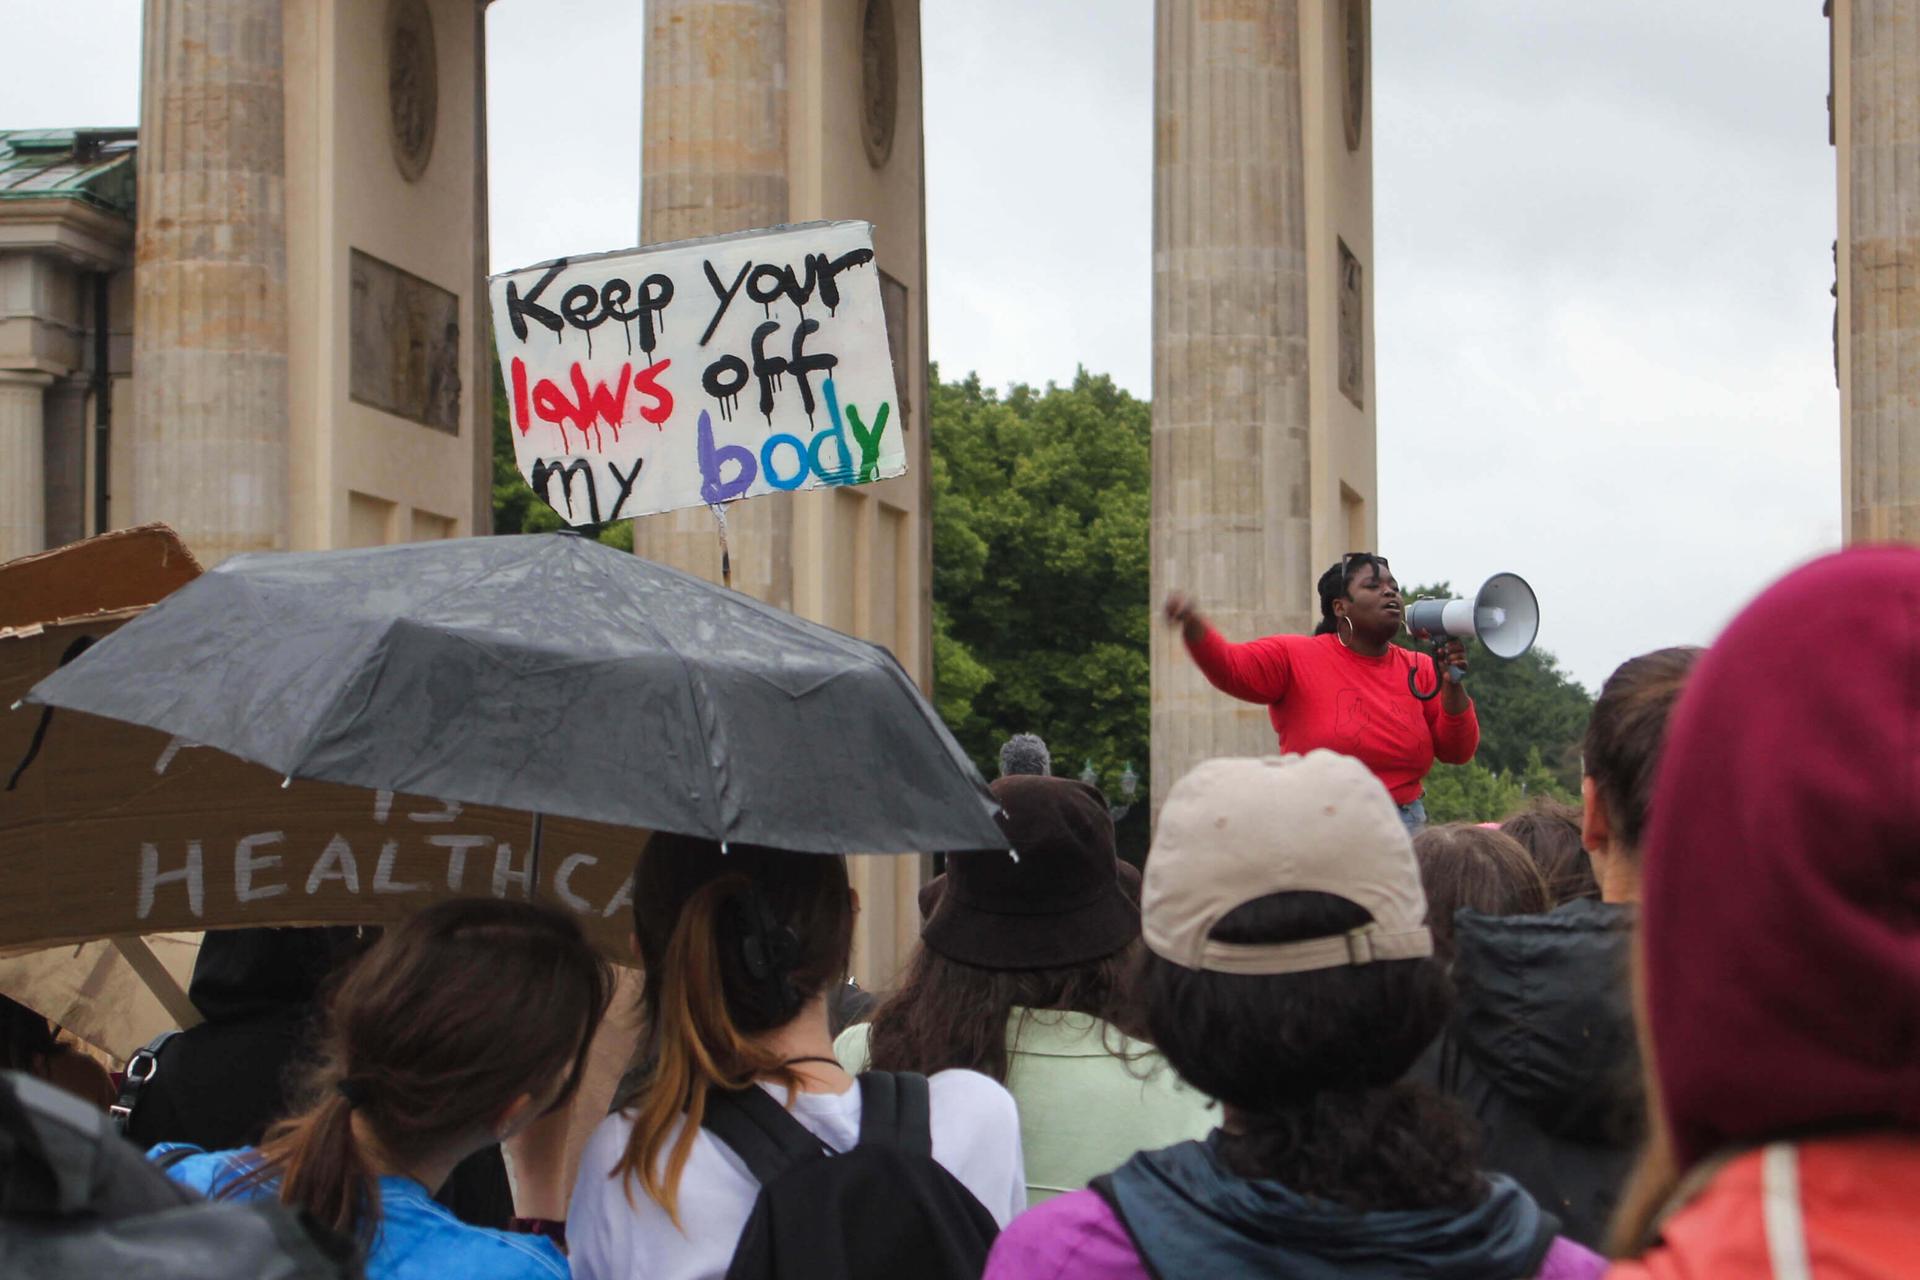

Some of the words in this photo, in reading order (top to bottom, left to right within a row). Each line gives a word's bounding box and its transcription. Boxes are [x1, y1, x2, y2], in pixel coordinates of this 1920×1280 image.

[507, 258, 674, 362] Keep
[700, 248, 873, 346] your
[511, 356, 674, 450] laws
[702, 318, 838, 428] off
[532, 457, 643, 522] my
[698, 378, 890, 505] body
